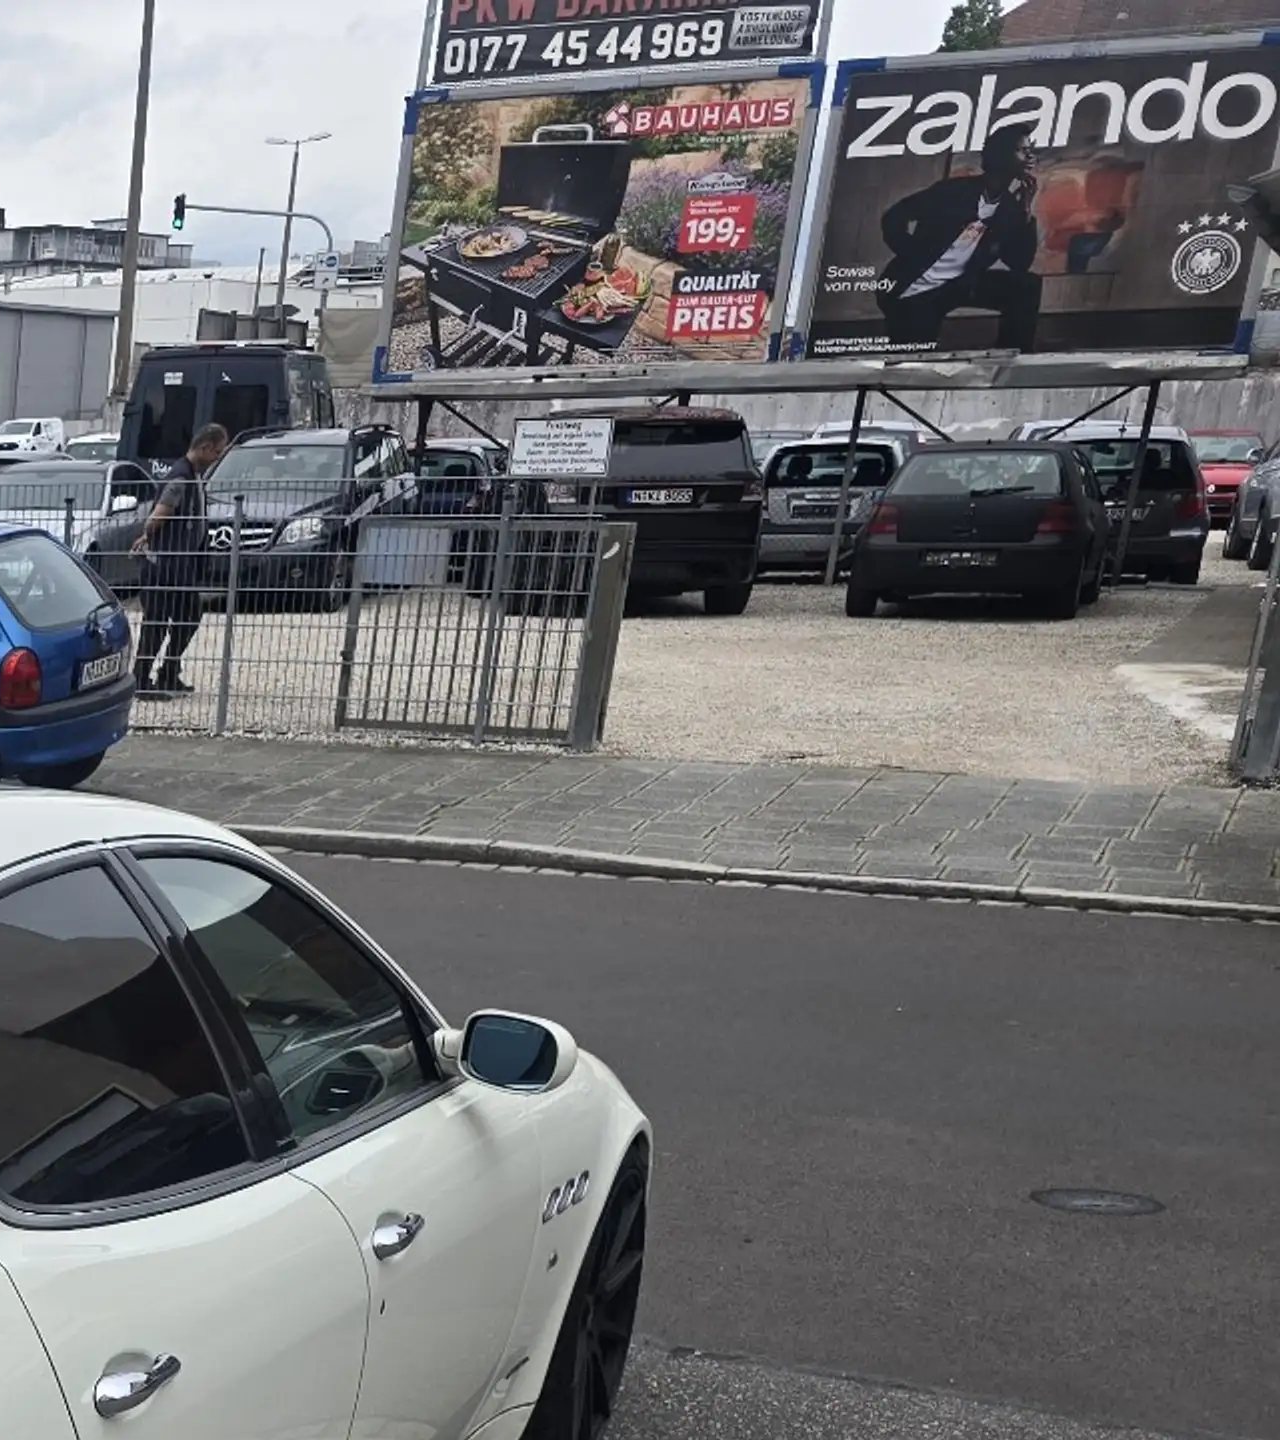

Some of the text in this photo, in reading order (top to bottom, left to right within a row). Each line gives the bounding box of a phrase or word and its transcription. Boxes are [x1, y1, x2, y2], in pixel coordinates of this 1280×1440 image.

[443, 34, 527, 75] 0177
[649, 19, 725, 60] 969
[635, 100, 791, 132] BAUHAUS
[846, 60, 1278, 160] zalando
[679, 270, 760, 292] QUALITÄT
[826, 266, 876, 279] Sowas
[824, 278, 897, 293] von ready
[676, 296, 700, 307] ZUM
[672, 305, 756, 332] PREIS
